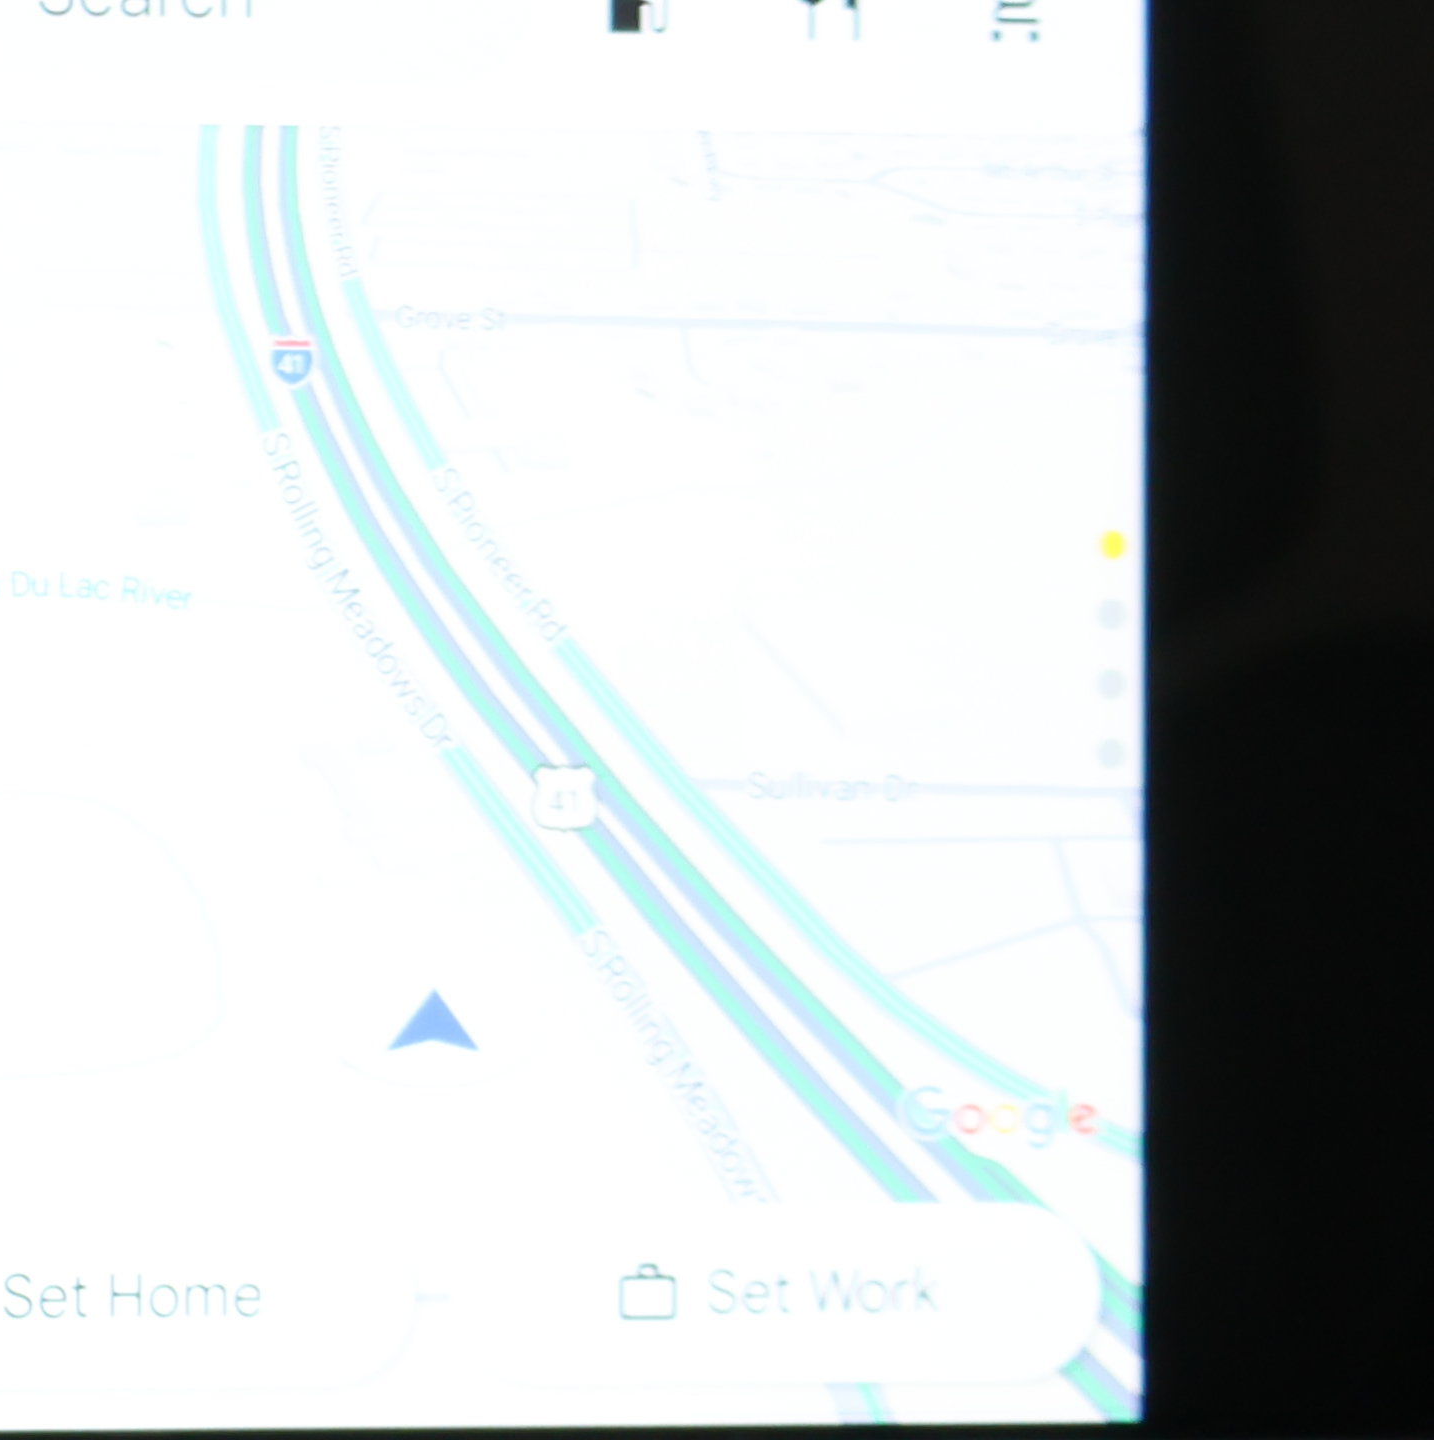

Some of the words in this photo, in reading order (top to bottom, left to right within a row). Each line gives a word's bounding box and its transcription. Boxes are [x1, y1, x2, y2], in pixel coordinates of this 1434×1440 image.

[448, 489, 534, 602] Pioneer
[10, 569, 51, 599] Du
[57, 570, 111, 601] Lac
[119, 574, 194, 611] River
[273, 458, 336, 572] Rolling
[327, 567, 429, 718] Meadows
[547, 786, 580, 815] 41
[903, 1085, 1100, 1151] Google
[1, 1271, 89, 1320] Set
[107, 1271, 264, 1320] Home
[706, 1266, 792, 1317] Set
[808, 1265, 941, 1316] Work
